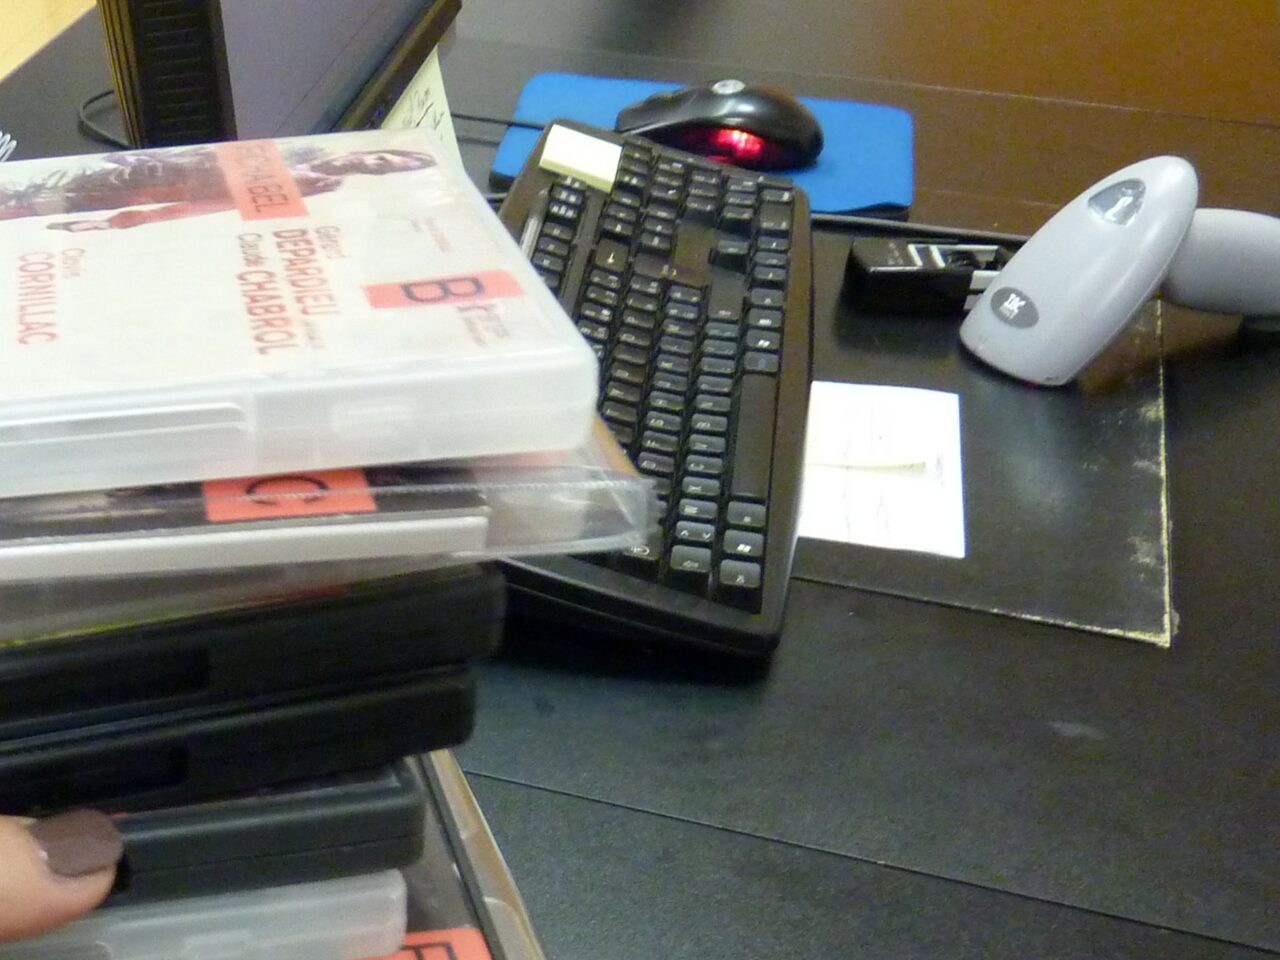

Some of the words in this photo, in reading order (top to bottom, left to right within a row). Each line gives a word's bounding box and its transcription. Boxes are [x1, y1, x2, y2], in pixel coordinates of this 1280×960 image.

[236, 232, 270, 268] Claude
[271, 228, 341, 316] DEPARDIEU
[400, 276, 486, 304] B
[18, 251, 59, 345] CORNILLAC
[236, 269, 300, 356] CHABROL
